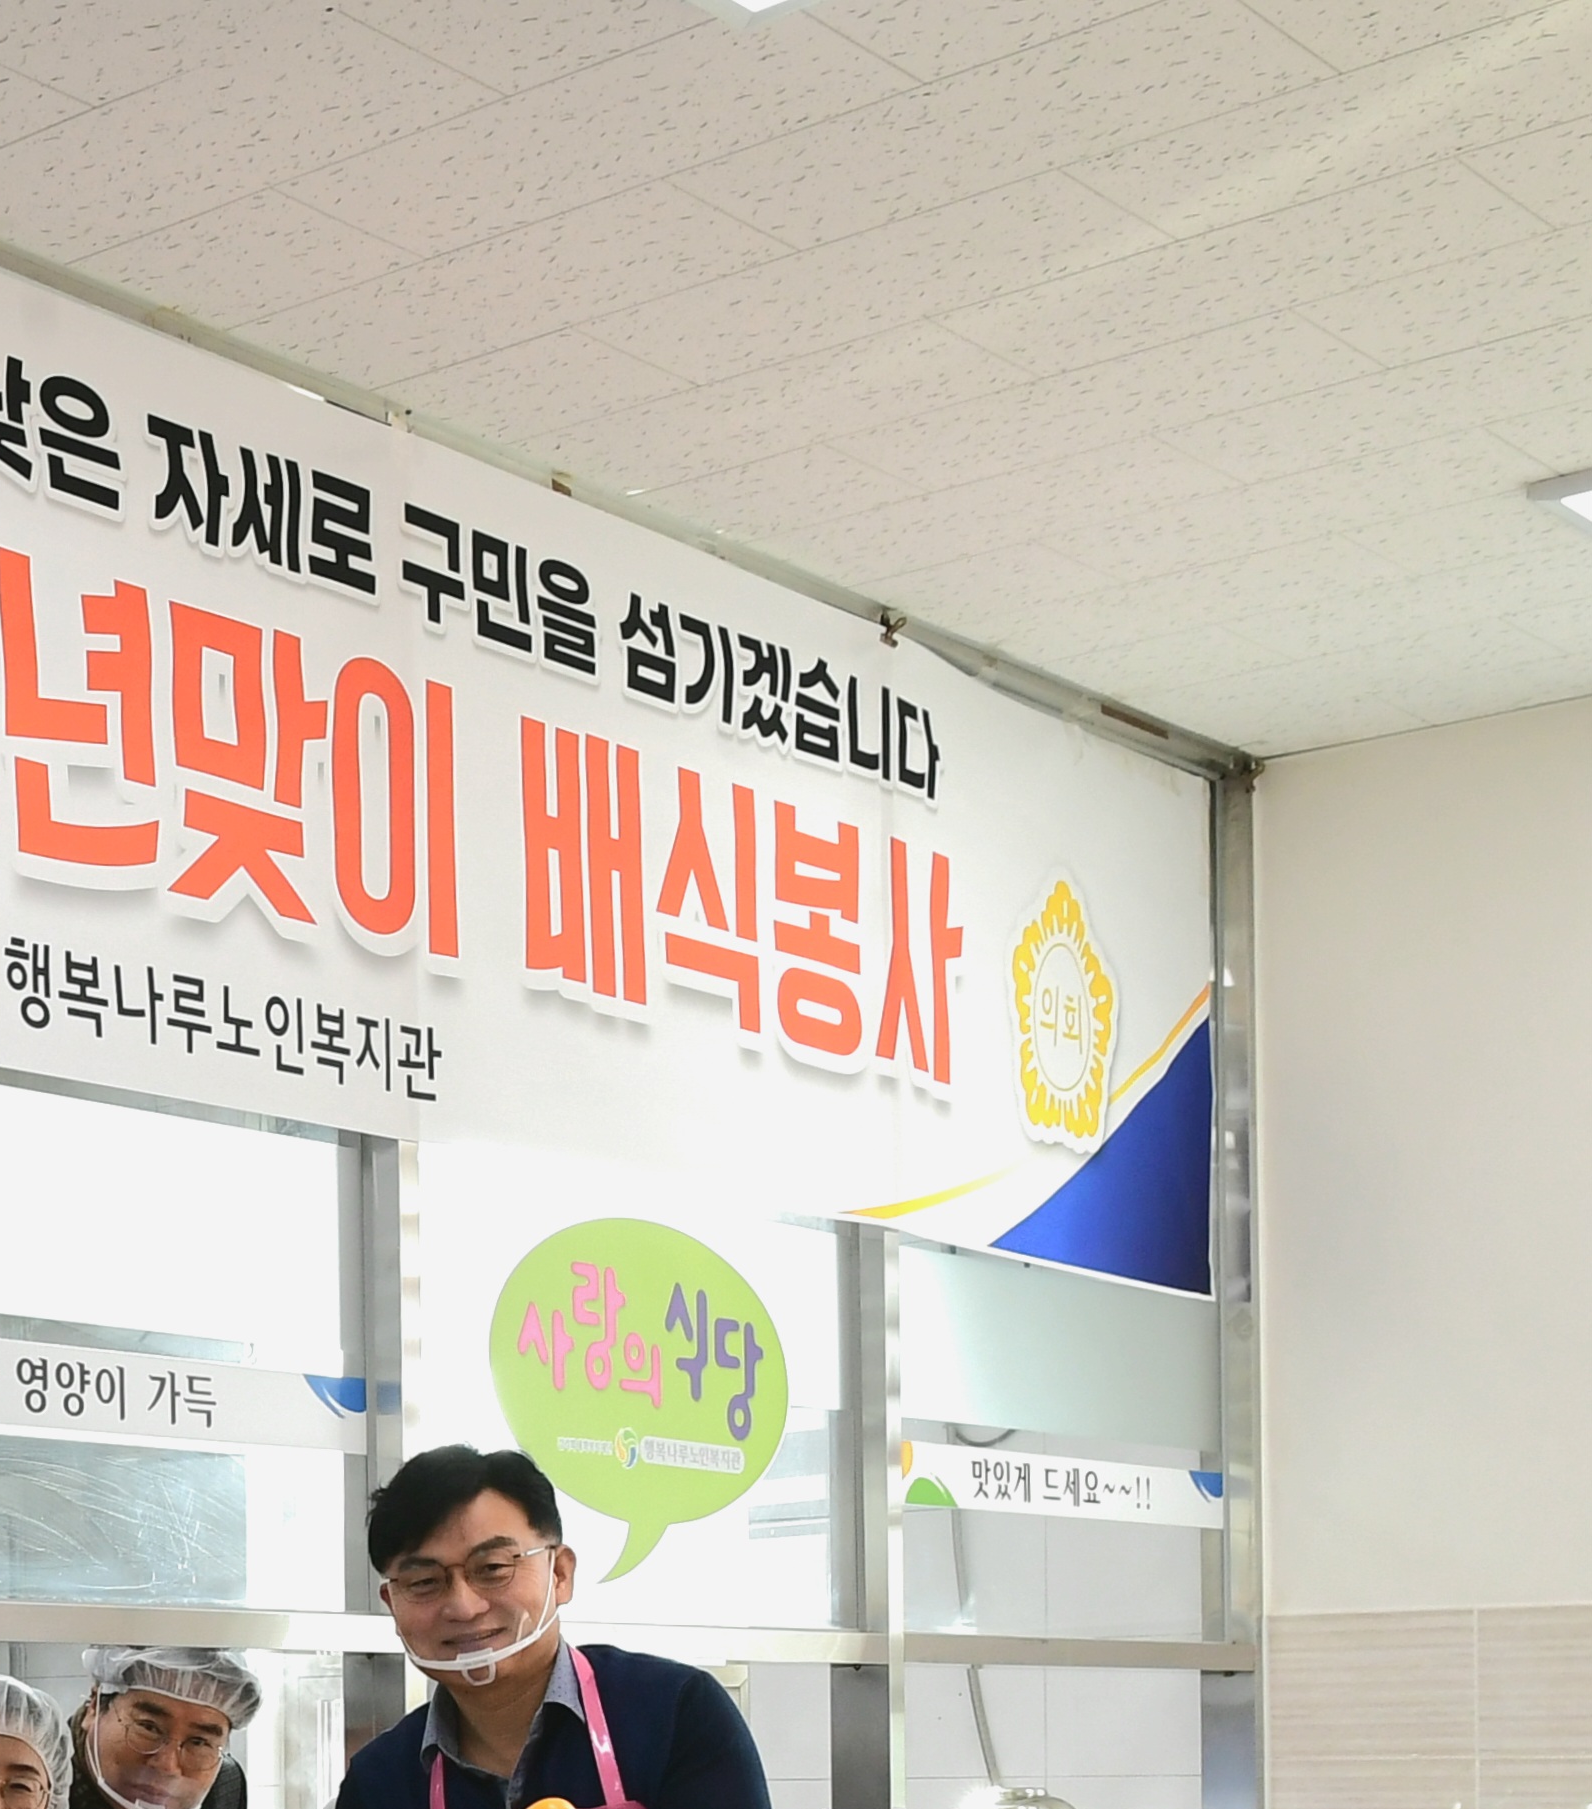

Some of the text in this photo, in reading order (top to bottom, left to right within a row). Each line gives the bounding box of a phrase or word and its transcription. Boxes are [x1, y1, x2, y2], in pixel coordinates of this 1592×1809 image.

[147, 413, 376, 595] 자세로
[402, 502, 597, 676] 구민을
[619, 592, 942, 800] 섬기겠습니다
[521, 716, 964, 1085] 배식봉사
[4, 937, 443, 1102] 행복나루노인복지관
[1040, 985, 1083, 1055] 의회
[16, 1357, 126, 1420] 영양이
[148, 1371, 217, 1428] 가득
[517, 1261, 765, 1441] 사랑의 식당
[971, 1459, 1031, 1503] 맛있게
